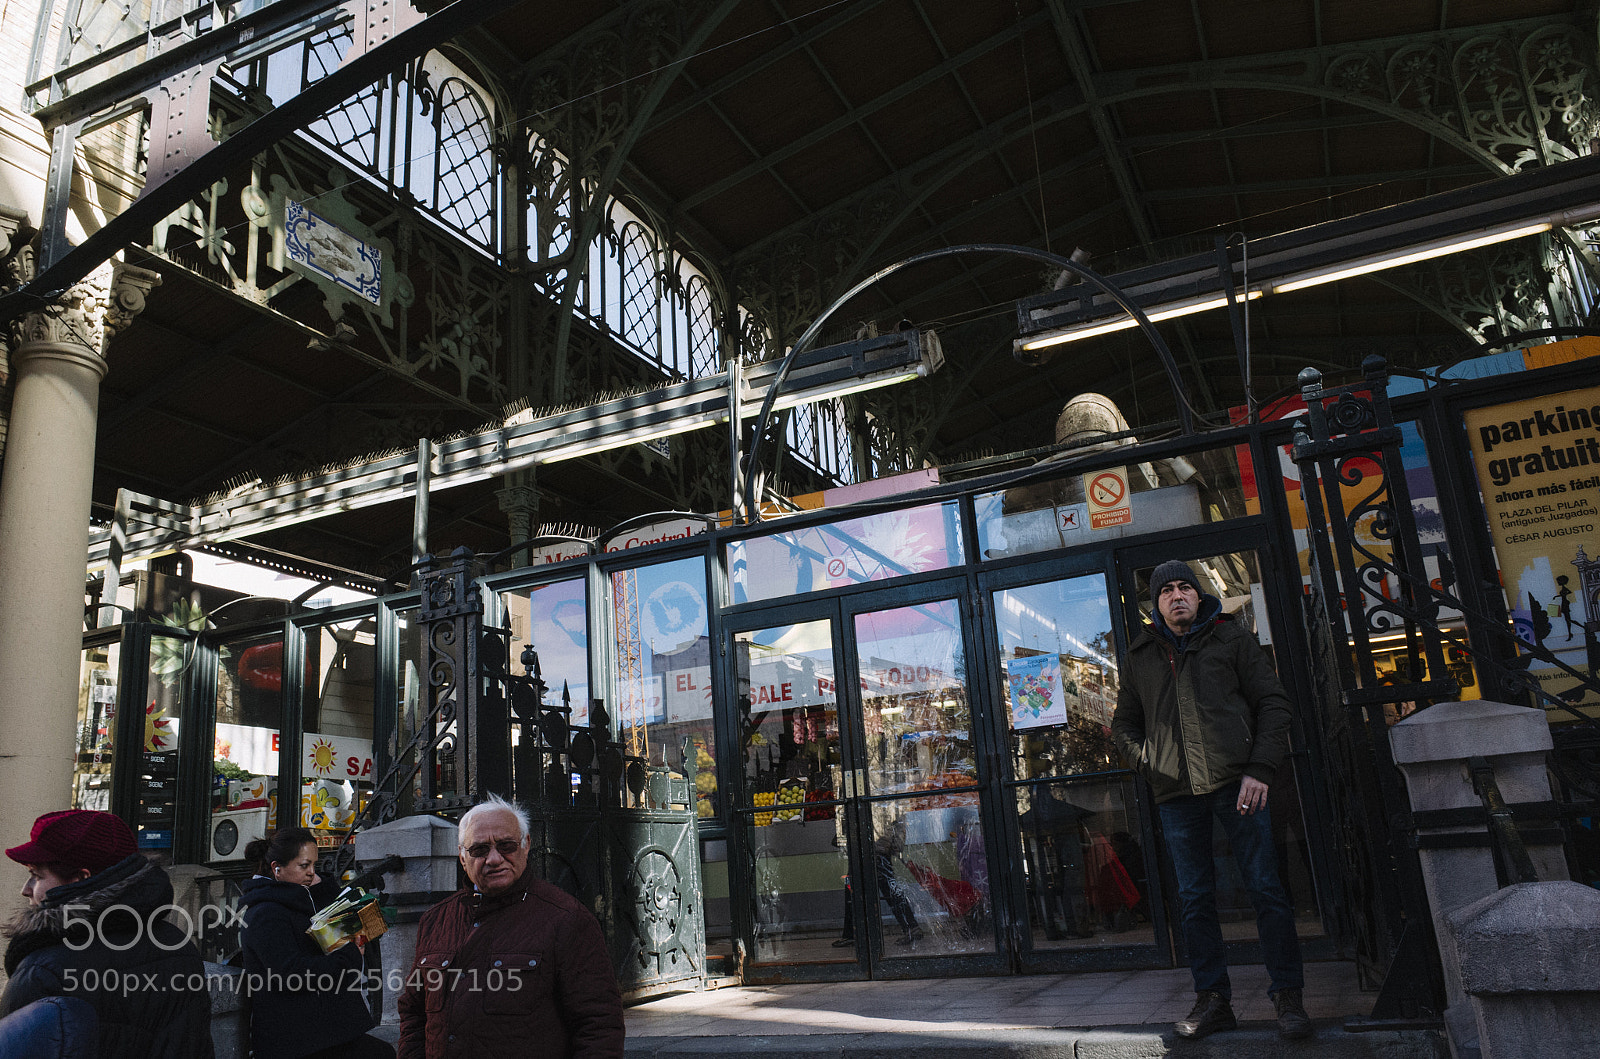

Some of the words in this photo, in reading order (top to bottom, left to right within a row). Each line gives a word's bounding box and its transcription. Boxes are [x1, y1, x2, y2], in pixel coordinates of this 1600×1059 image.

[1495, 489, 1534, 504] ahora
[1537, 482, 1567, 498] más
[1568, 475, 1600, 492] fácil
[1092, 509, 1129, 521] PROHIBIDO
[1500, 506, 1533, 520] PLAZA
[1534, 503, 1556, 514] DEL
[1557, 498, 1588, 511] PILAR
[1501, 516, 1546, 530] (antiguos
[1548, 506, 1598, 521] Juzgados)
[1100, 517, 1123, 526] FUMAR
[1505, 532, 1541, 545] CÉSAR
[1542, 524, 1594, 538] AUGUSTO
[676, 673, 697, 692] EL
[750, 682, 793, 705] SALE
[346, 757, 373, 777] SA
